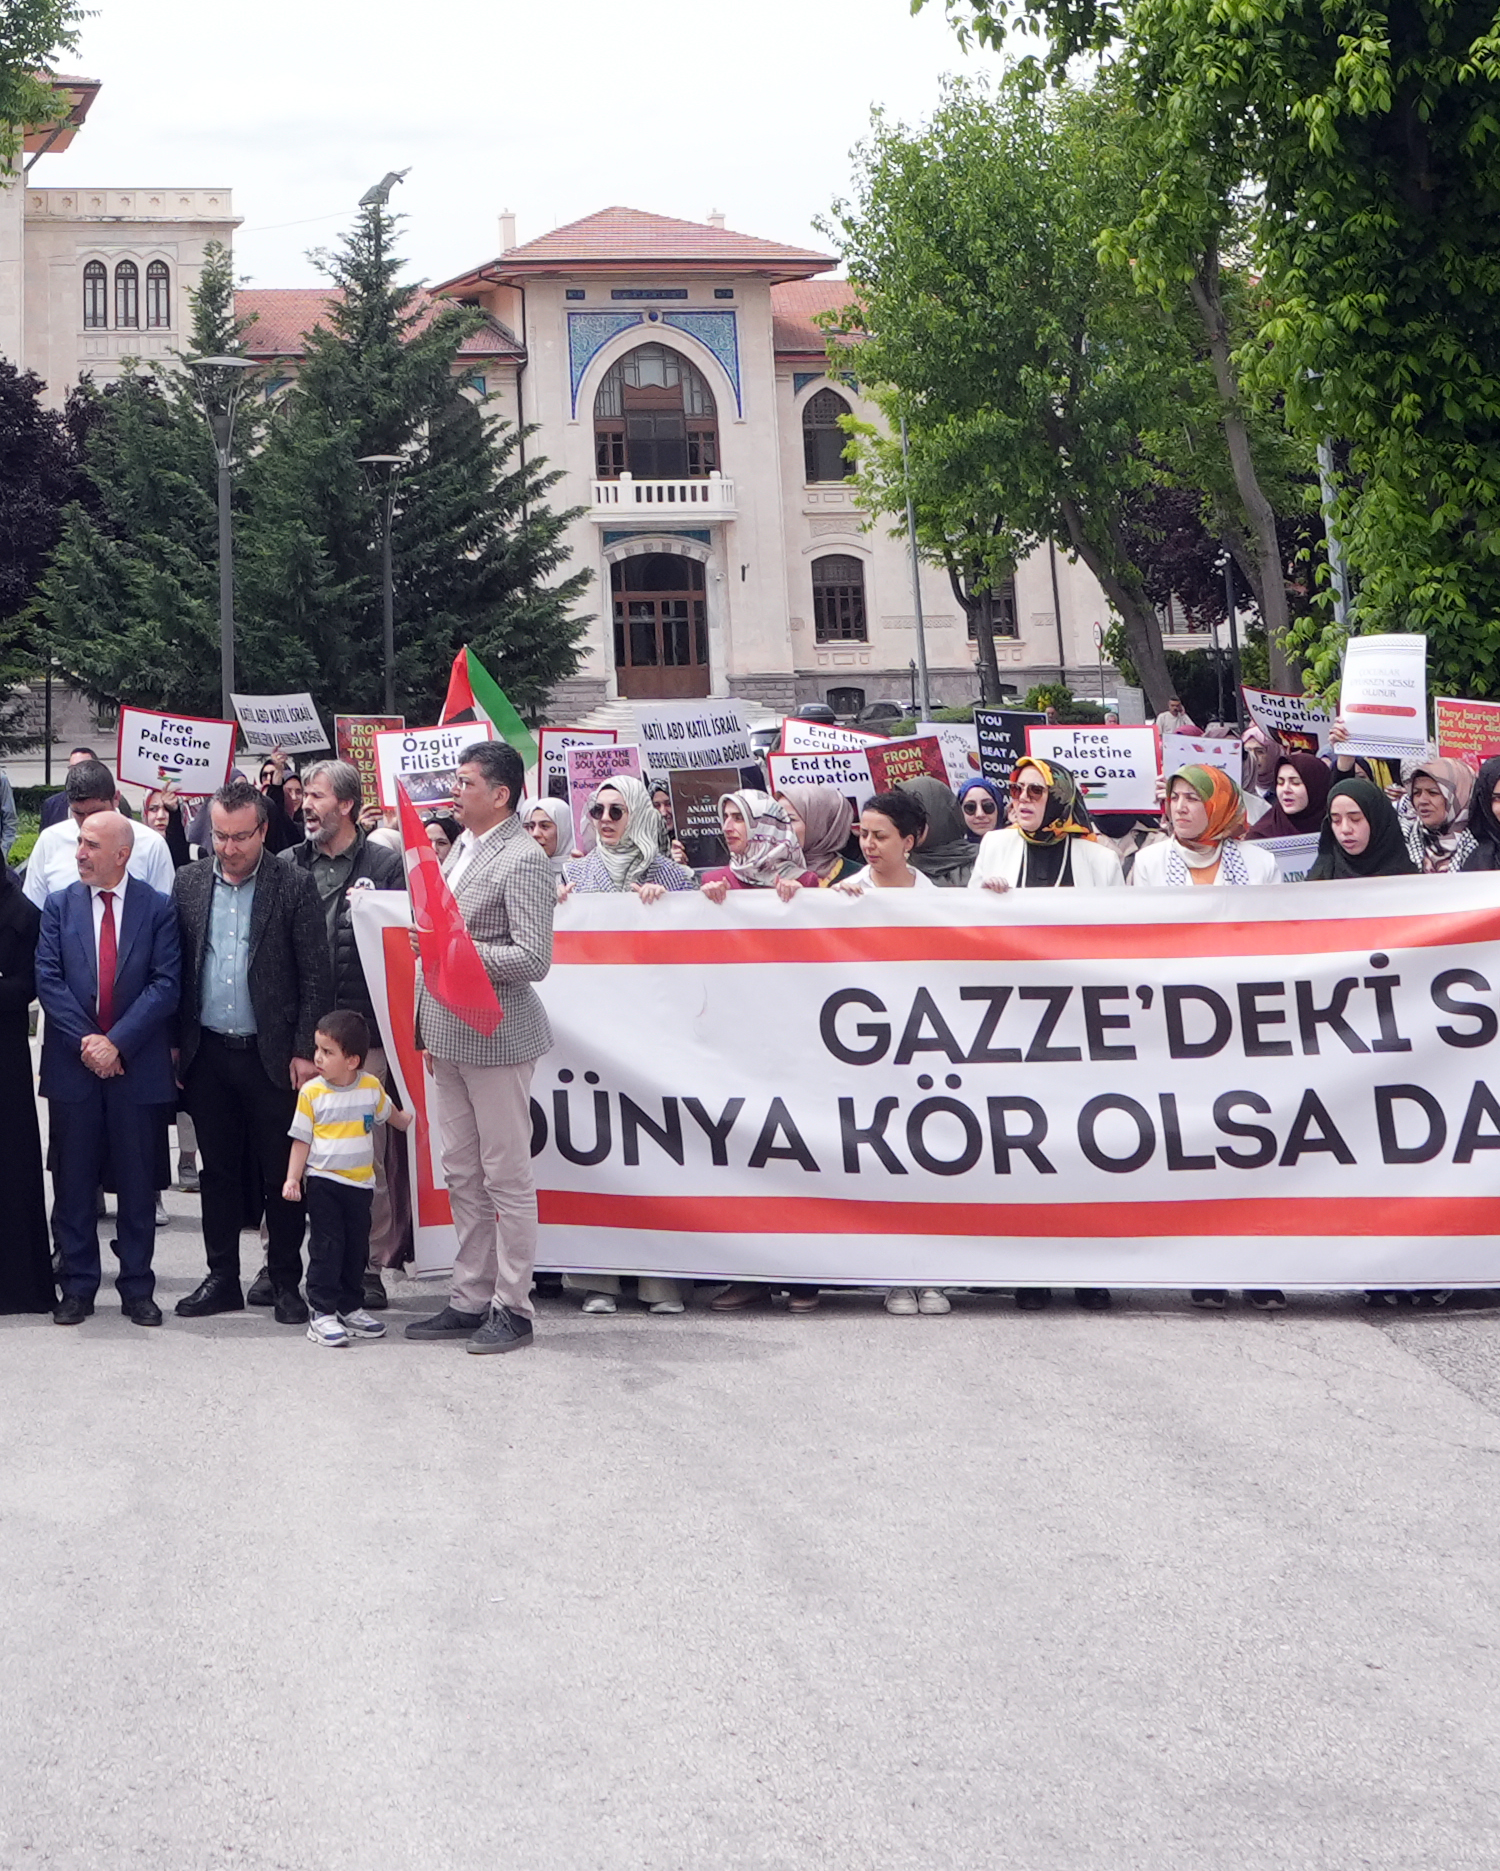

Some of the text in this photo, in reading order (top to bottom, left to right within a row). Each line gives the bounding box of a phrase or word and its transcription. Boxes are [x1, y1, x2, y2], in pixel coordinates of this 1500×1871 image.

[1261, 695, 1306, 709] End th
[978, 714, 1002, 726] YOU
[1251, 704, 1330, 723] occupation
[1463, 709, 1499, 723] buried
[161, 719, 193, 735] Free
[642, 710, 741, 740] KATİL ABD KATİL İSRAİL
[1275, 720, 1304, 732] now
[1458, 719, 1482, 733] they
[141, 728, 211, 750] Palestine
[351, 737, 373, 747] RIV
[809, 726, 868, 745] End the
[1073, 732, 1109, 745] Free
[1468, 733, 1486, 742] we
[403, 732, 463, 755] Özgür
[138, 746, 210, 767] Free Gaza
[348, 749, 365, 759] TO
[882, 747, 922, 764] FROM
[981, 746, 1018, 759] BEAT A
[1053, 746, 1132, 760] Palestine
[401, 751, 461, 771] Filisti
[791, 757, 851, 771] End the
[983, 761, 1014, 774] COUN
[886, 760, 925, 777] RIVER
[1069, 766, 1136, 779] ee Gaza
[779, 769, 869, 786] occupation
[687, 804, 717, 813] ANAHT
[819, 952, 1413, 1067] GAZZE'DEKİ
[843, 1073, 1059, 1176] KÖR
[1078, 1091, 1351, 1174] OLSA
